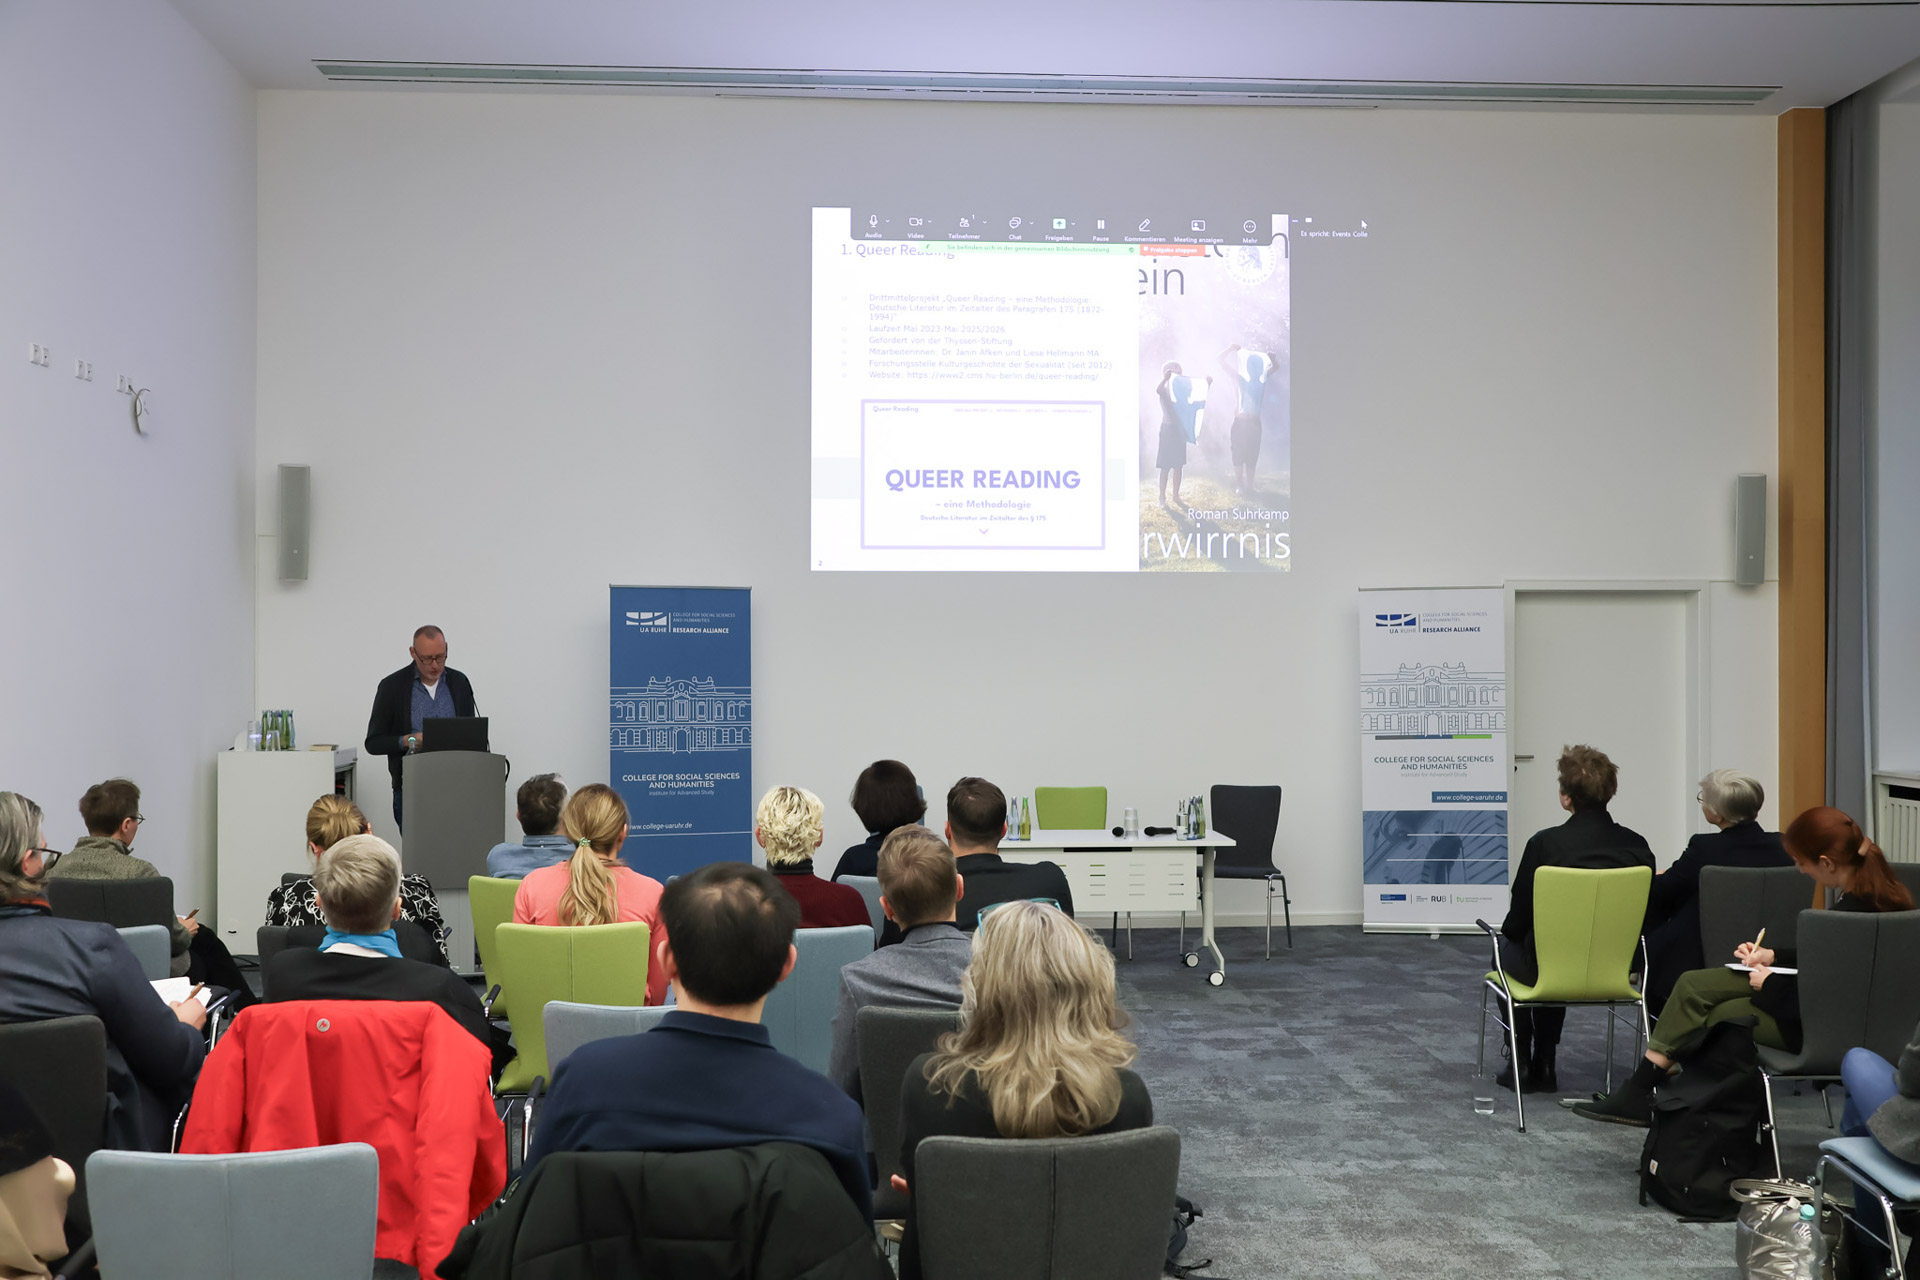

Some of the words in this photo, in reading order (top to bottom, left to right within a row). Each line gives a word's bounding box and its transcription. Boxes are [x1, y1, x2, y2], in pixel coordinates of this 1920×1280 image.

[842, 244, 852, 255] 1.
[856, 244, 896, 258] Queer
[869, 294, 939, 303] Drittmittelprojekt
[974, 295, 1006, 304] Reading
[1013, 305, 1057, 314] Paragrafen
[961, 326, 1006, 334] 2025/2026
[944, 337, 1013, 346] Thyssen-Stiftung
[869, 360, 936, 368] Forschungsstelle
[939, 360, 1006, 369] Kulturgeschichte
[1025, 360, 1065, 368] Sexualität
[1068, 361, 1085, 370] (seit
[1088, 361, 1112, 370] 2012)
[885, 469, 964, 492] QUEER
[973, 470, 1080, 489] READING
[944, 500, 964, 508] eine
[966, 500, 1031, 510] Methodologie
[1188, 508, 1228, 520] Roman
[1232, 508, 1290, 522] Suhrkamp
[1143, 523, 1291, 559] rwirrnis
